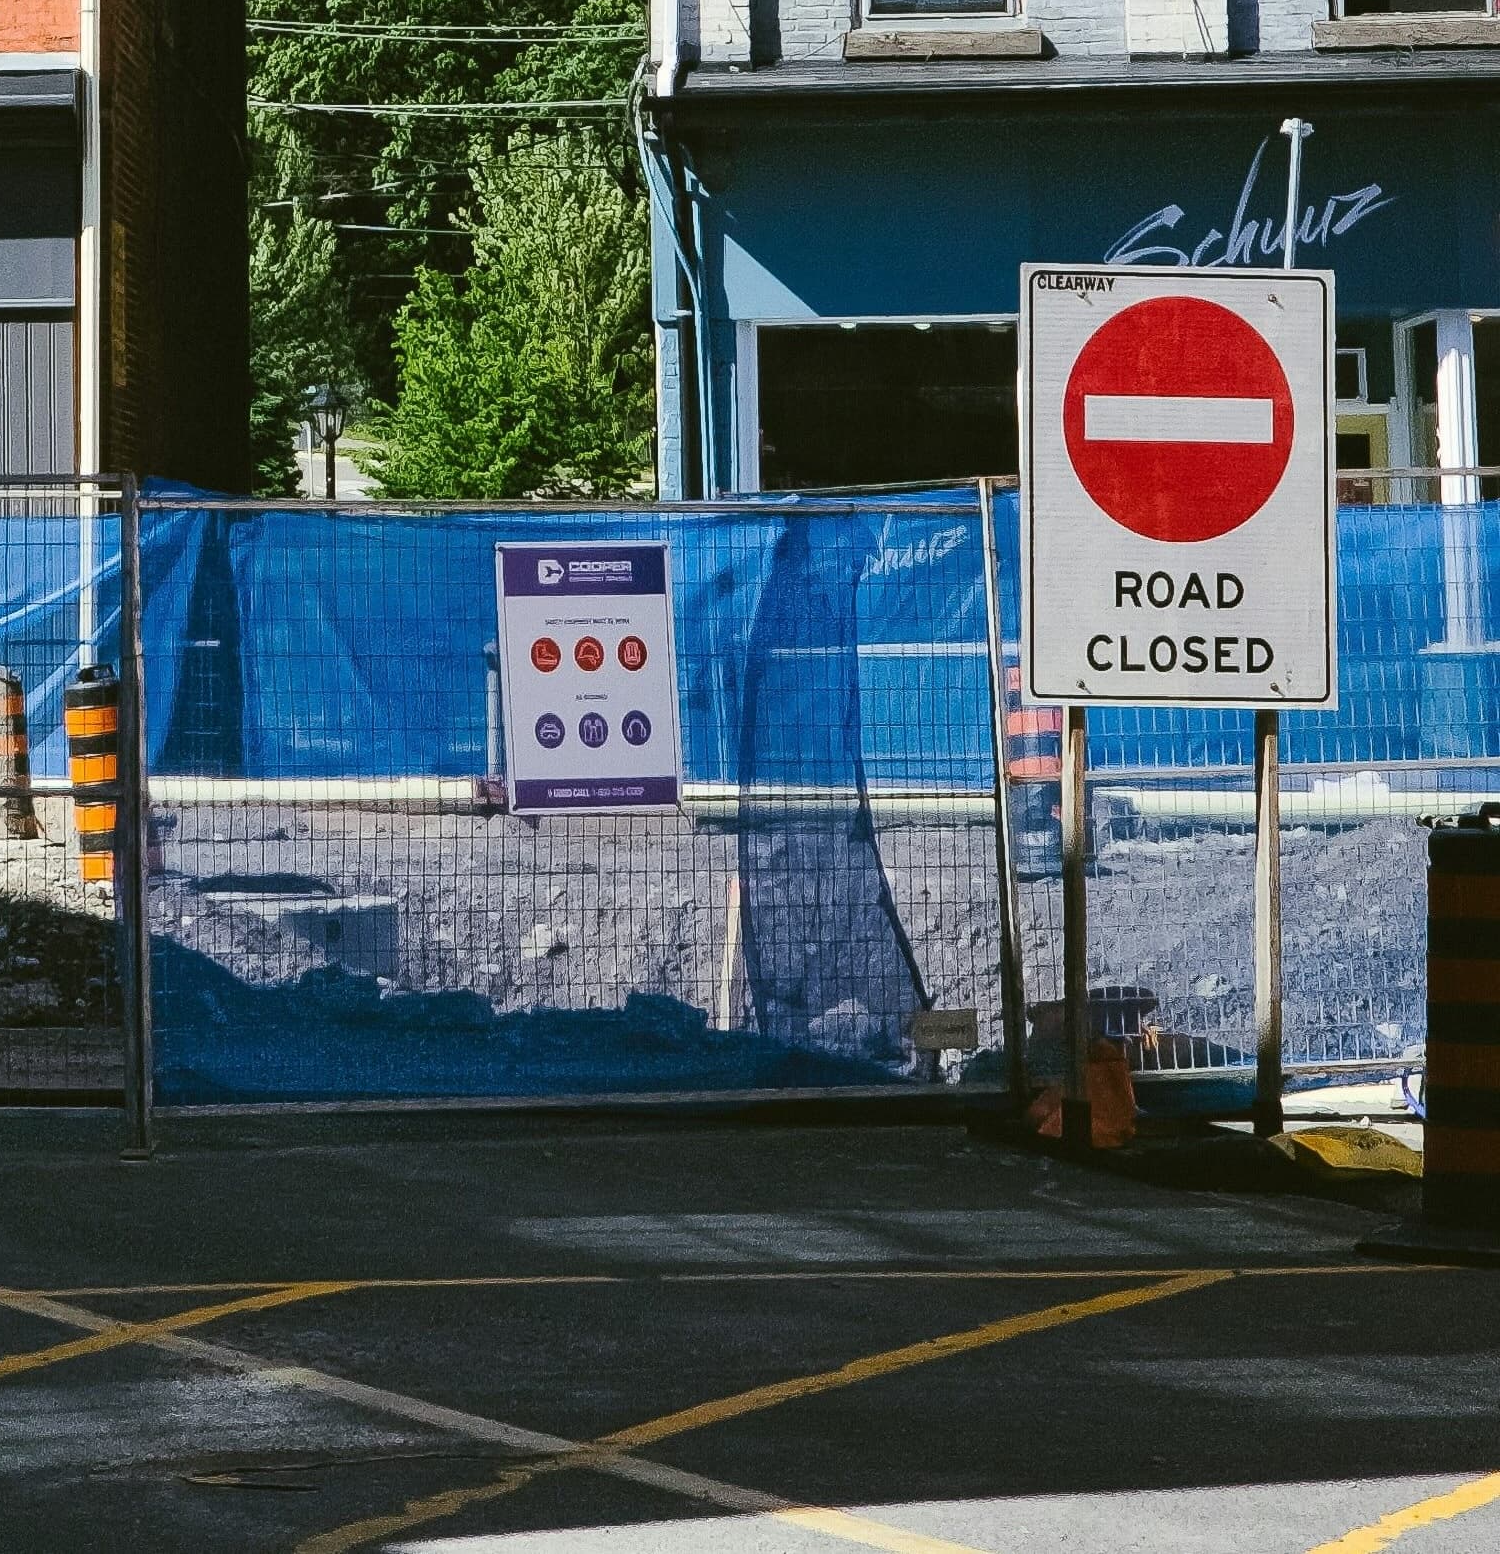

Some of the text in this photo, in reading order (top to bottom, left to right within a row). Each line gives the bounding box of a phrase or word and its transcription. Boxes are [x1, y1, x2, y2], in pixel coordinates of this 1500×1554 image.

[1037, 274, 1115, 292] CLEARWAY
[1115, 571, 1244, 609] ROAD
[1087, 634, 1274, 673] CLOSED
